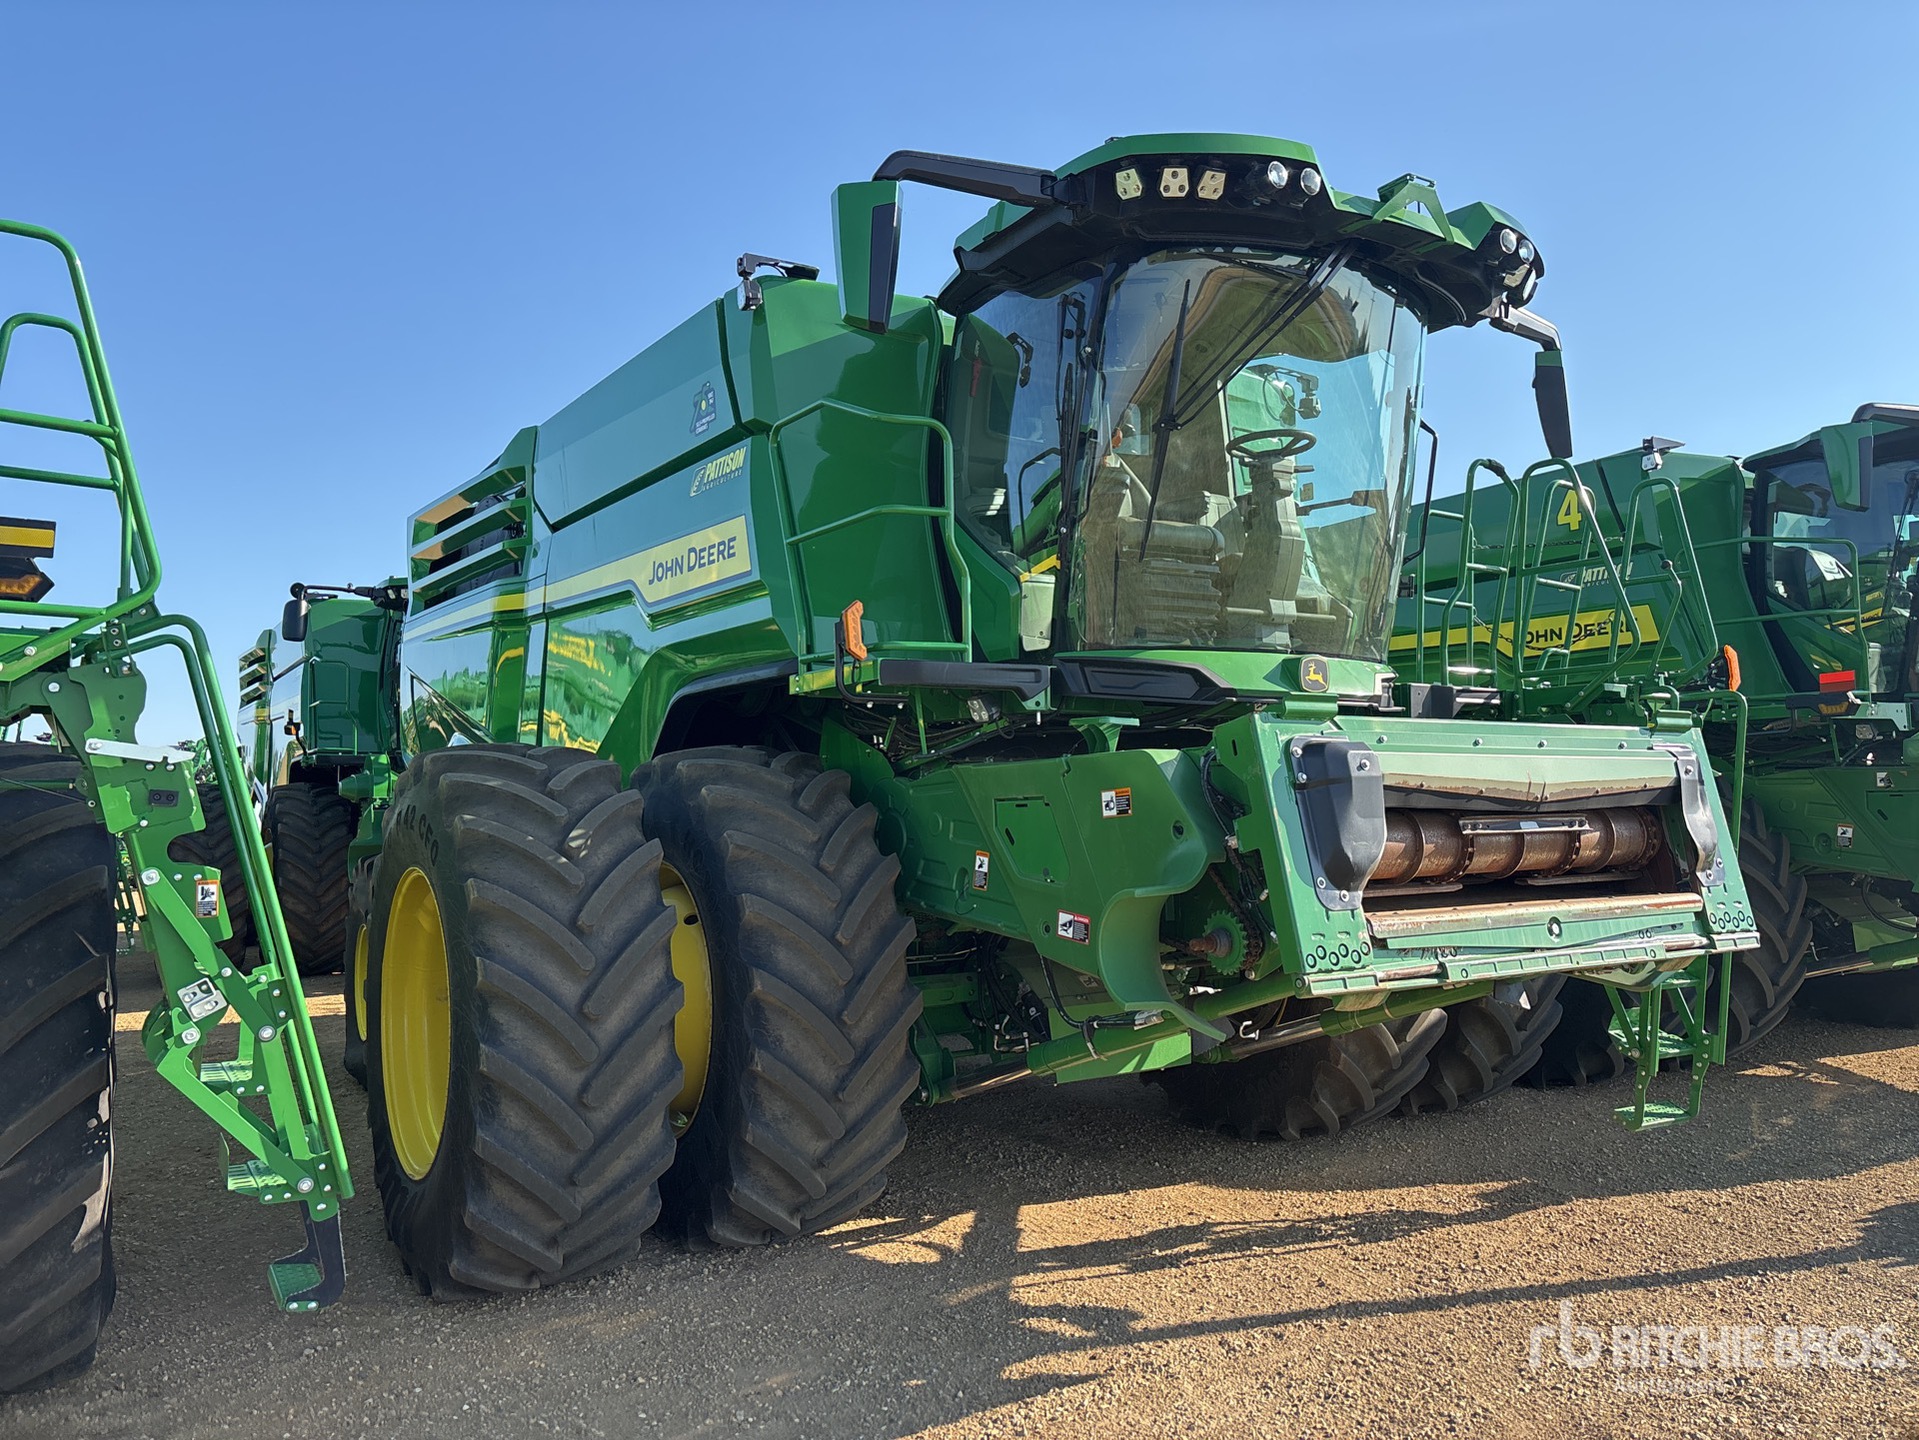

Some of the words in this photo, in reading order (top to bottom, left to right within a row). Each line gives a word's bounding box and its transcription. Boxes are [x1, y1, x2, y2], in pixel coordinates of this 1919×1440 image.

[704, 446, 747, 484] PATTISON
[1557, 489, 1582, 531] 4
[648, 554, 684, 585] JOHN
[687, 535, 737, 572] DEERE
